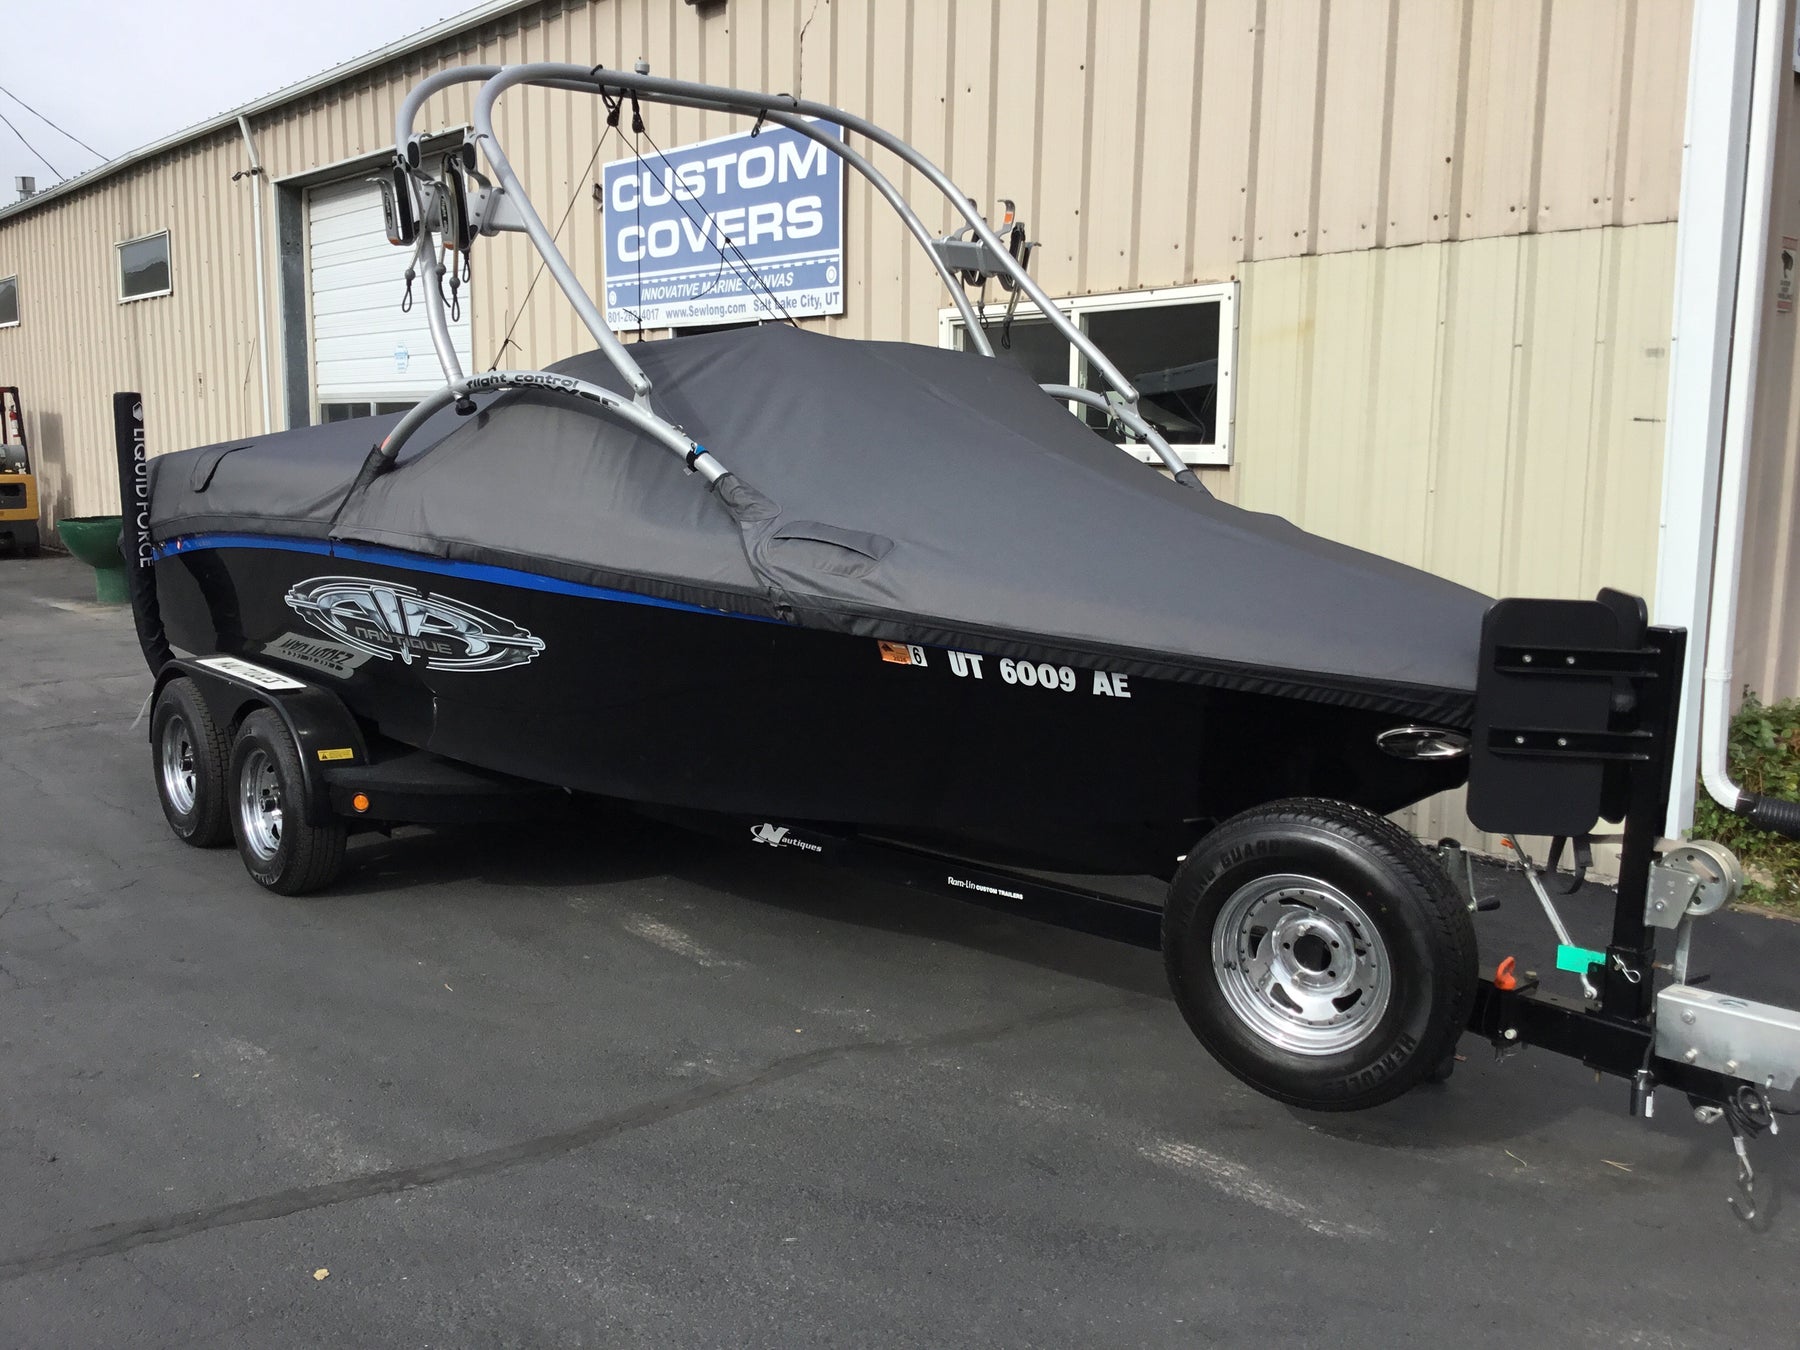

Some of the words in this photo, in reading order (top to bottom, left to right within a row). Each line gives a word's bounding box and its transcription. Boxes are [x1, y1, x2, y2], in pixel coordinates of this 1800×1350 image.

[612, 139, 828, 212] CUSTOM
[617, 195, 824, 262] COVERS
[641, 279, 699, 301] INNOVATIVE
[701, 276, 743, 297] MARINE
[747, 271, 794, 292] CANVAS
[607, 307, 660, 323] 801-2624017
[665, 302, 747, 320] www.Sewlong.com
[753, 299, 771, 312] Salt
[801, 294, 822, 311] City,
[826, 291, 840, 306] UT
[466, 373, 507, 390] flight
[514, 374, 579, 389] control
[133, 428, 150, 498] LIQUID
[136, 502, 154, 568] FORCE
[354, 625, 454, 655] NAUTIQUE
[912, 646, 923, 665] 6
[947, 650, 984, 679] UT
[999, 657, 1076, 692] 6009
[1092, 670, 1132, 698] AE
[750, 822, 823, 853] Nautiques
[947, 876, 976, 890] Ram-Lin
[976, 884, 998, 896] CUSTOM
[998, 889, 1024, 901] TRAILERS
